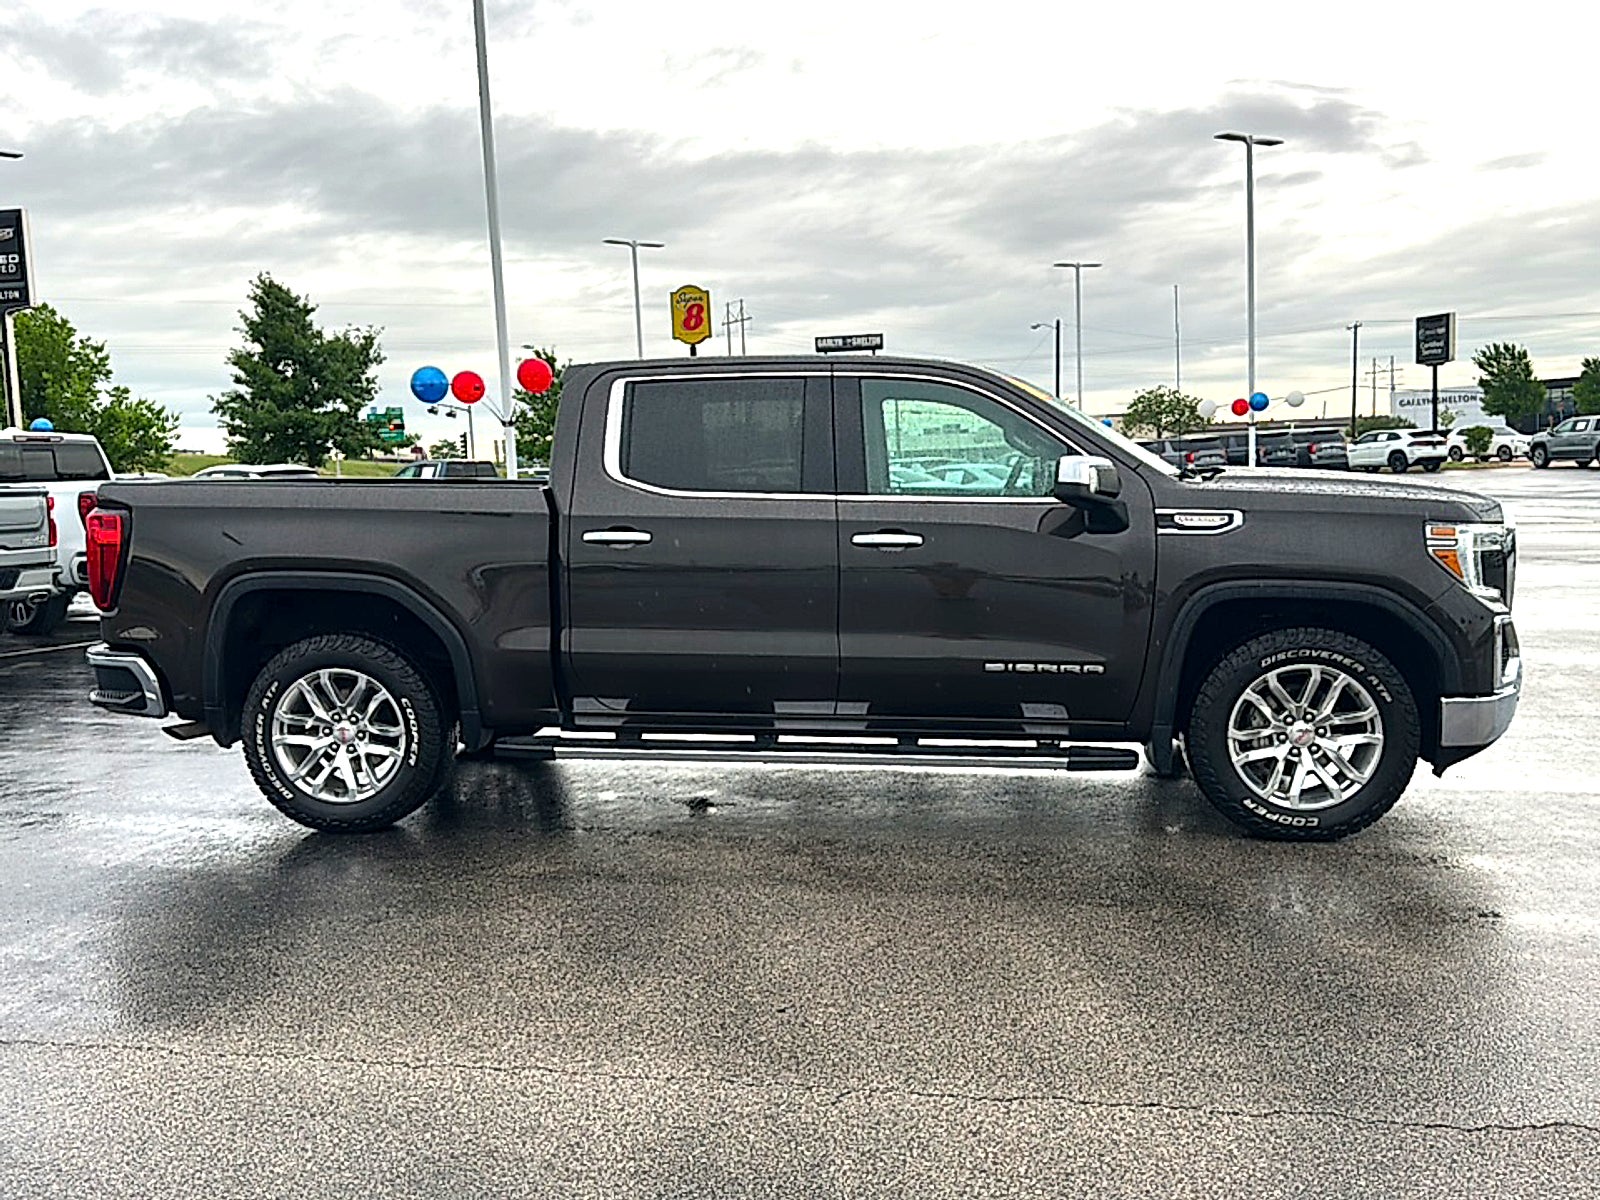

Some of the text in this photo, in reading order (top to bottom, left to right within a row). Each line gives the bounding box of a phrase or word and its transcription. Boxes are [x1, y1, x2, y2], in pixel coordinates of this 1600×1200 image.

[683, 303, 704, 331] 8
[984, 662, 1105, 674] SIERRA
[1260, 649, 1394, 703] DISCOVERER ATP
[255, 697, 419, 800] COOPER DISCOVERER
[1242, 798, 1320, 827] COOPER
